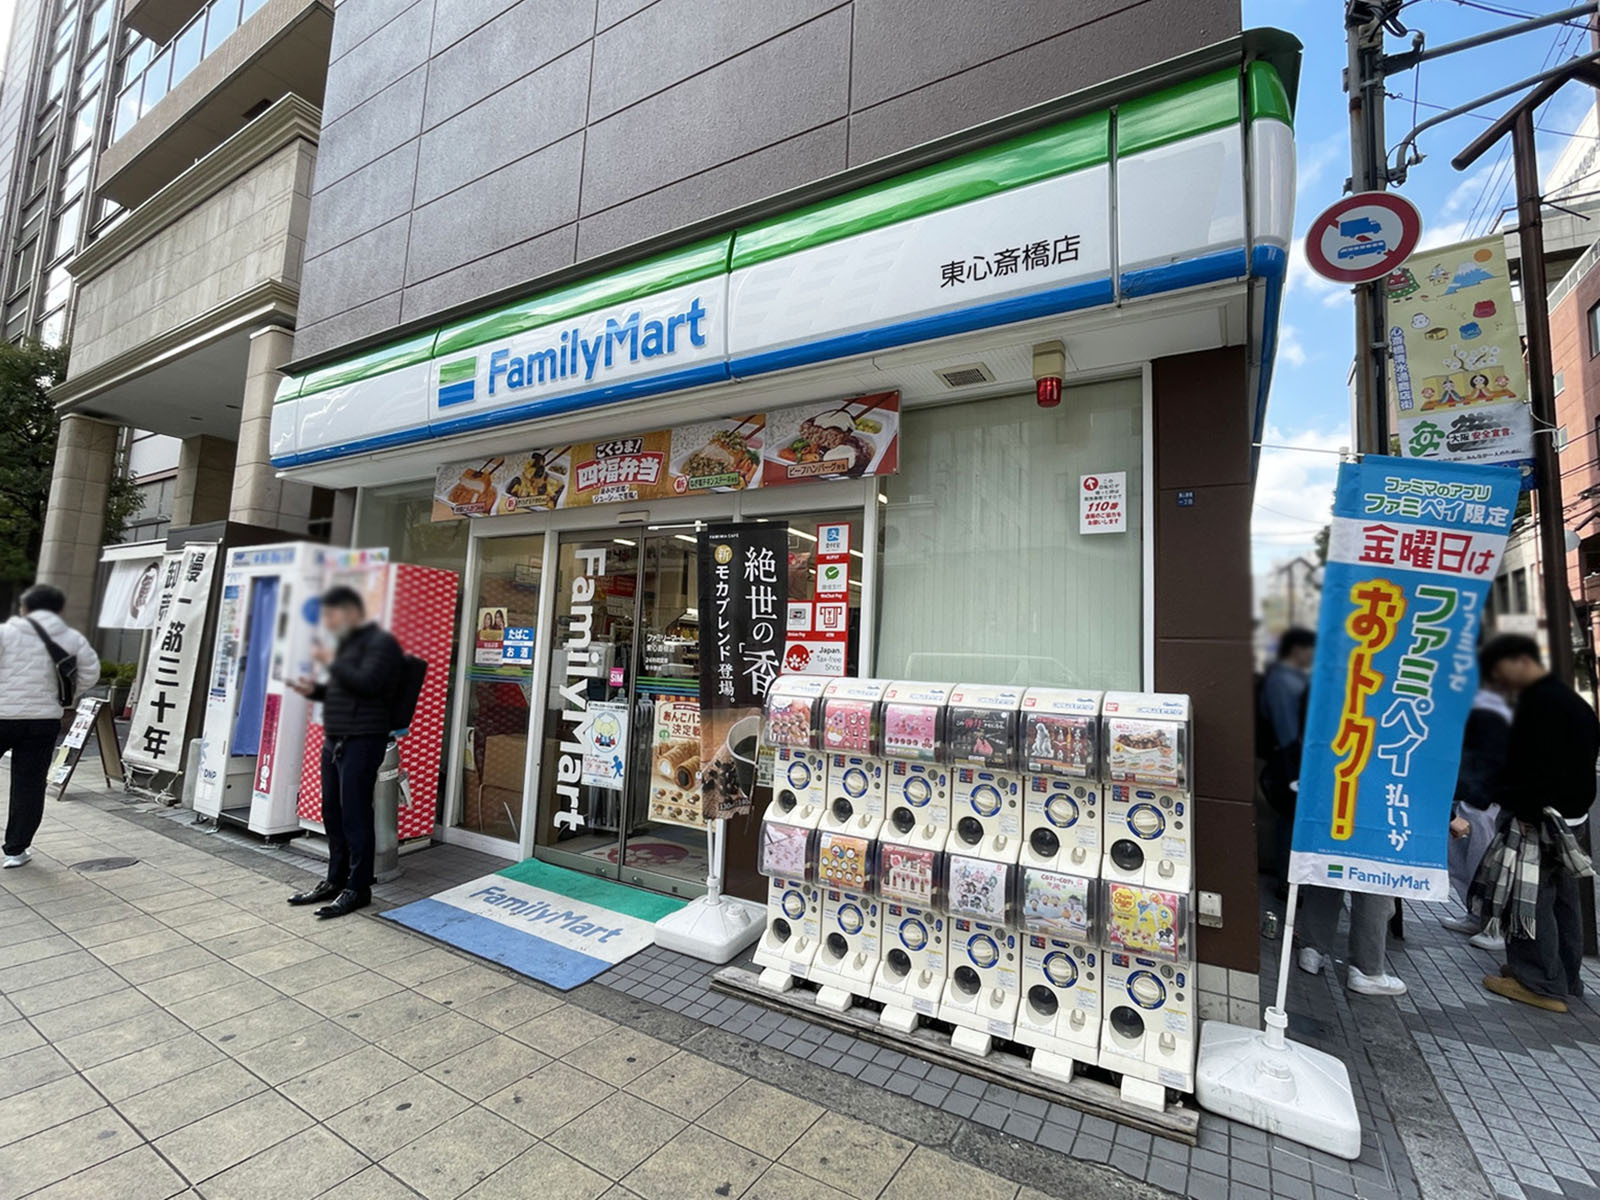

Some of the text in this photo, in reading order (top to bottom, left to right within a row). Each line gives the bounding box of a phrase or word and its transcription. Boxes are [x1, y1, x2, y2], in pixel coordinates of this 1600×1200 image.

[940, 235, 1081, 288] 東心斎橋店
[488, 298, 706, 395] FamilyMart
[1451, 434, 1470, 443] 大阪
[578, 457, 660, 489] 四福弁当
[1386, 477, 1491, 501] ファミマのアプリ
[1365, 494, 1510, 527] ファミペイ限定
[1359, 524, 1495, 574] 金曜日は
[508, 628, 529, 640] たばこ
[715, 566, 735, 702] モカブレンド登場。
[610, 673, 624, 682] SIM
[825, 663, 841, 671] Shop
[553, 548, 606, 832] FamilyMart
[204, 768, 217, 779] DNP
[1348, 867, 1431, 891] FamilyMart
[470, 886, 625, 944] FamilyMart
